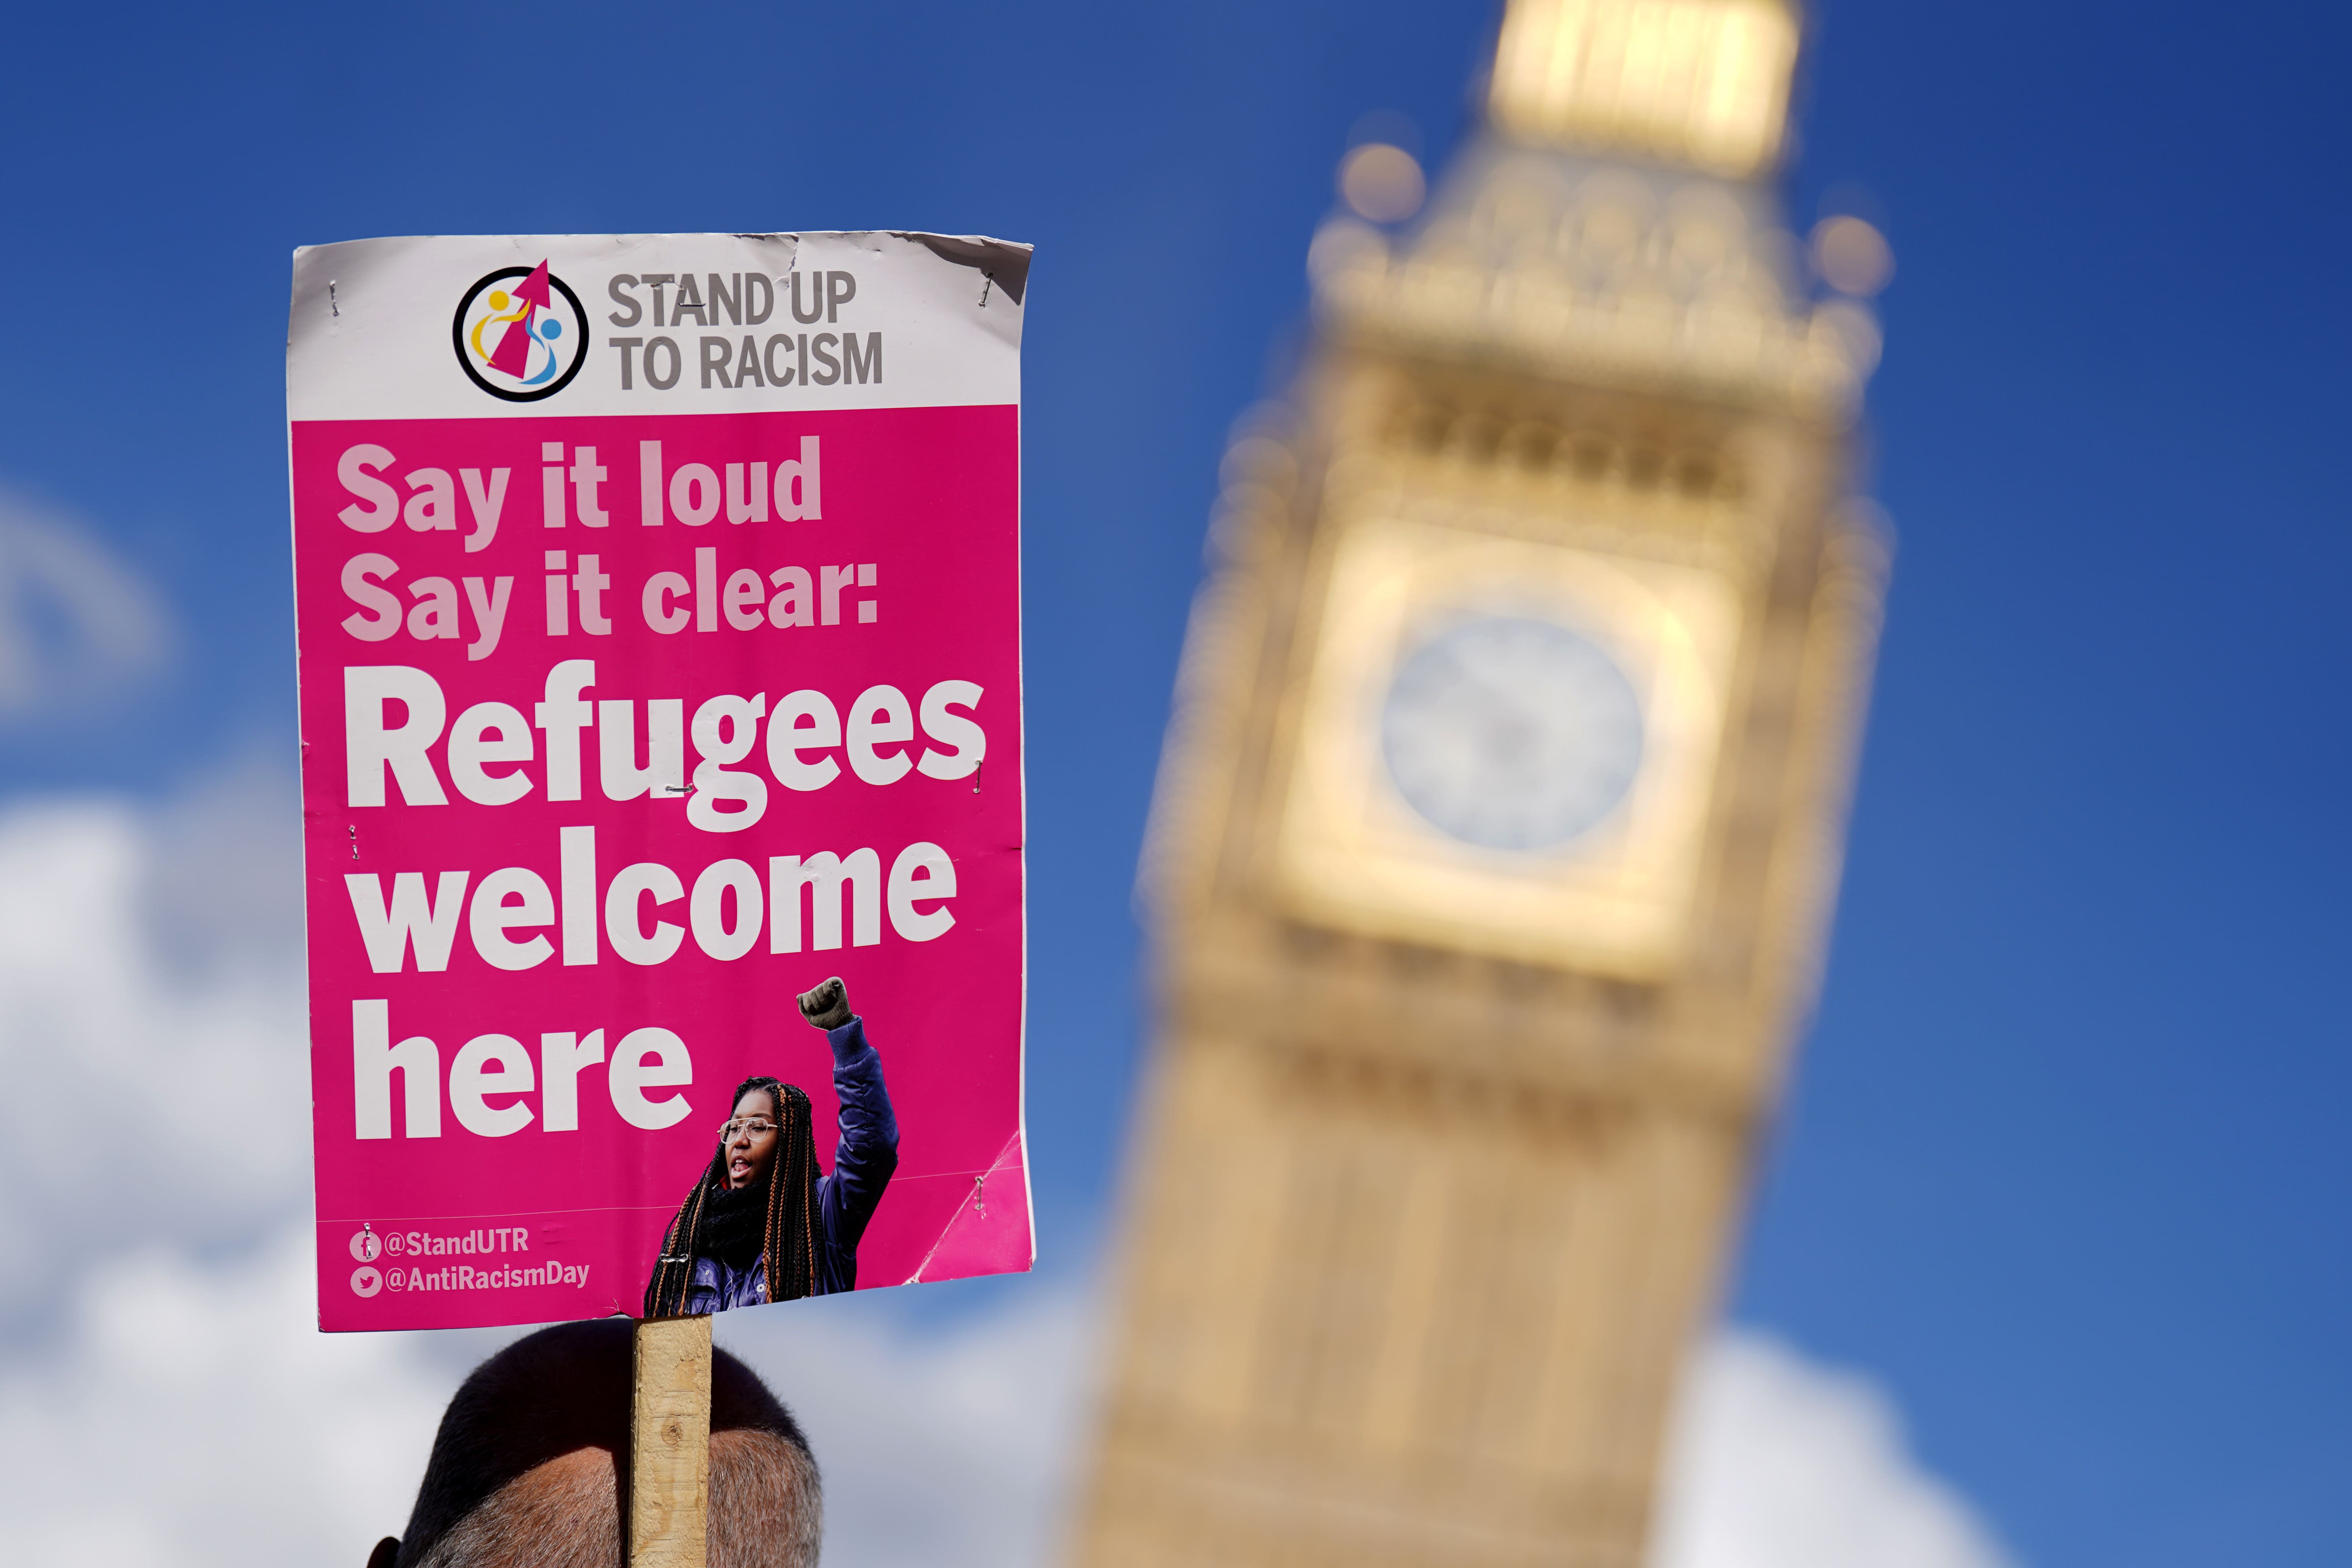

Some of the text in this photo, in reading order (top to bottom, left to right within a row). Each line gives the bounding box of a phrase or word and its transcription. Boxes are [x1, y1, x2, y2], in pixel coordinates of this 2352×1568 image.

[608, 271, 856, 327] STAND UP
[609, 332, 882, 390] TO RACISM
[337, 436, 822, 552] Say it loud
[341, 547, 877, 661] Say it clear:
[344, 659, 986, 832] Refugees
[344, 826, 956, 973] welcome
[352, 999, 692, 1139] here
[385, 1228, 528, 1256] @StandUTR
[386, 1261, 589, 1292] @AntiRacismDay
